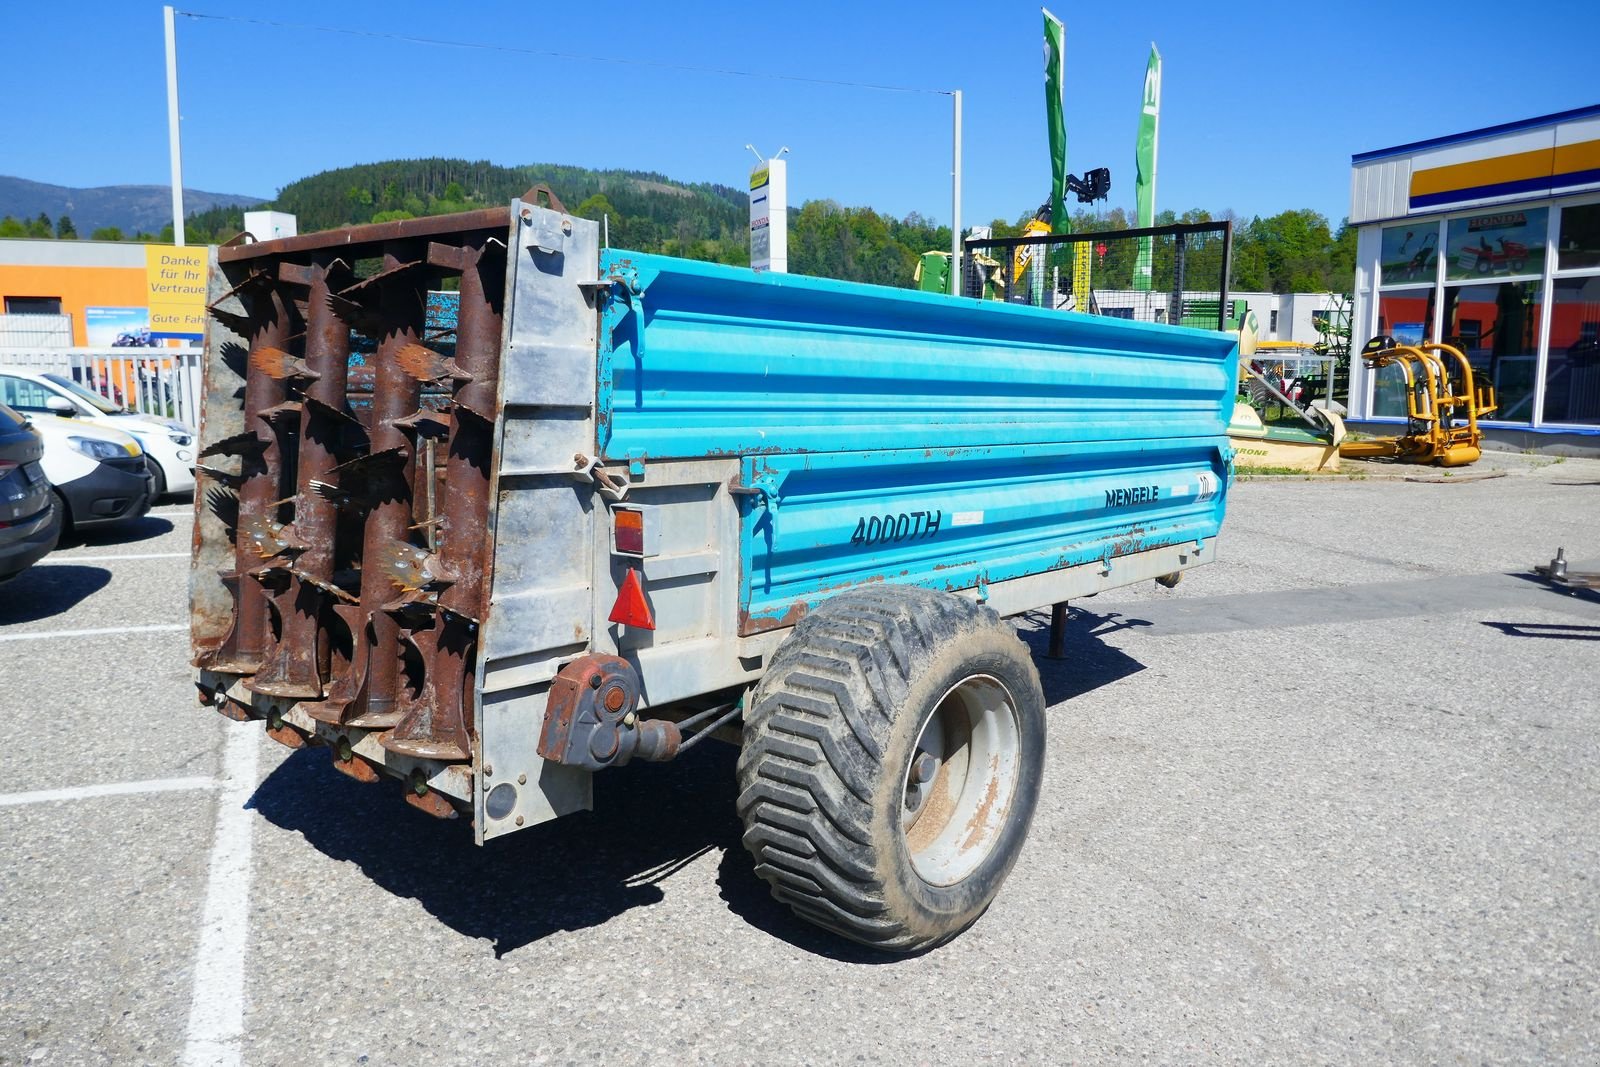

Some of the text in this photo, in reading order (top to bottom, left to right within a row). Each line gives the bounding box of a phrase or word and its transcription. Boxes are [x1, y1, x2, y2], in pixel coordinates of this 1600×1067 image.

[1469, 213, 1525, 229] HONDA
[161, 255, 201, 266] Danke
[160, 269, 200, 280] für Ihr
[151, 283, 206, 294] Vertraue
[152, 313, 204, 324] Gute Fah
[1105, 485, 1159, 508] MENGELE
[850, 510, 941, 545] 4000TH
